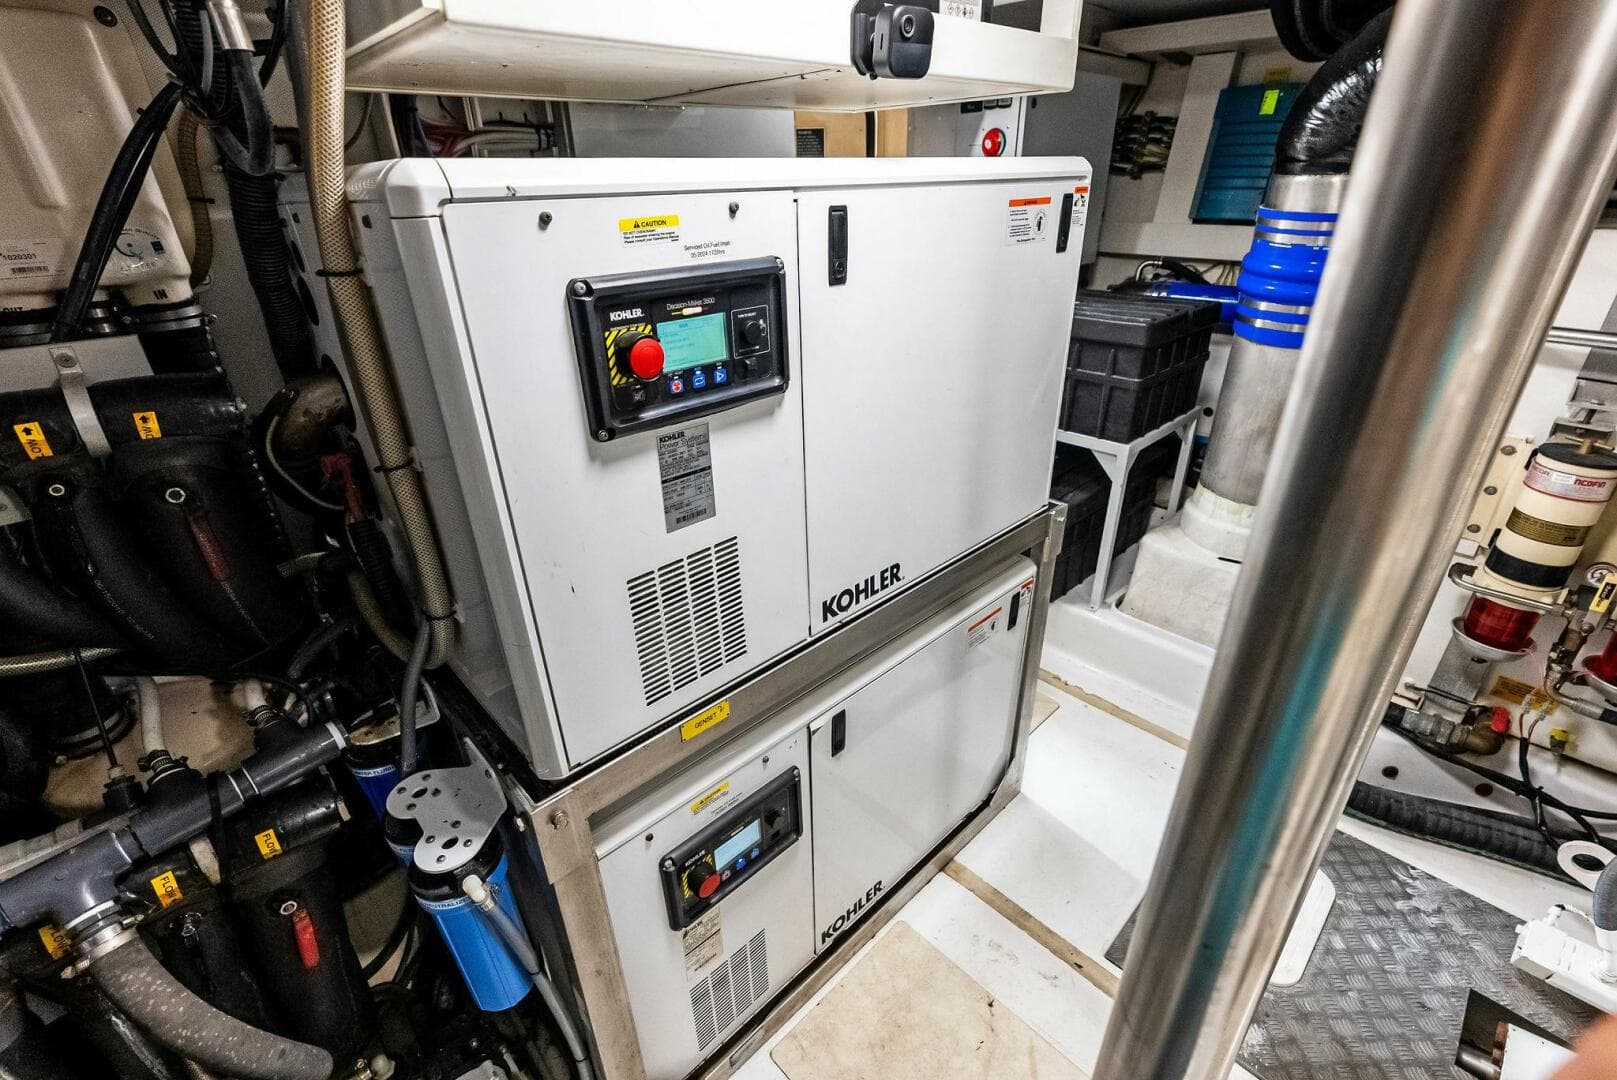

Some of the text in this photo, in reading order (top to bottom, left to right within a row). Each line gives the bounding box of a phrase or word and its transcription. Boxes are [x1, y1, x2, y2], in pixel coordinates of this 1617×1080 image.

[640, 219, 667, 228] CAUTION
[153, 289, 169, 300] IN
[609, 308, 643, 321] KOHLER
[659, 431, 685, 443] KOHLER
[659, 441, 680, 450] Power
[822, 562, 902, 624] KOHLER
[821, 879, 883, 945] KOHLER
